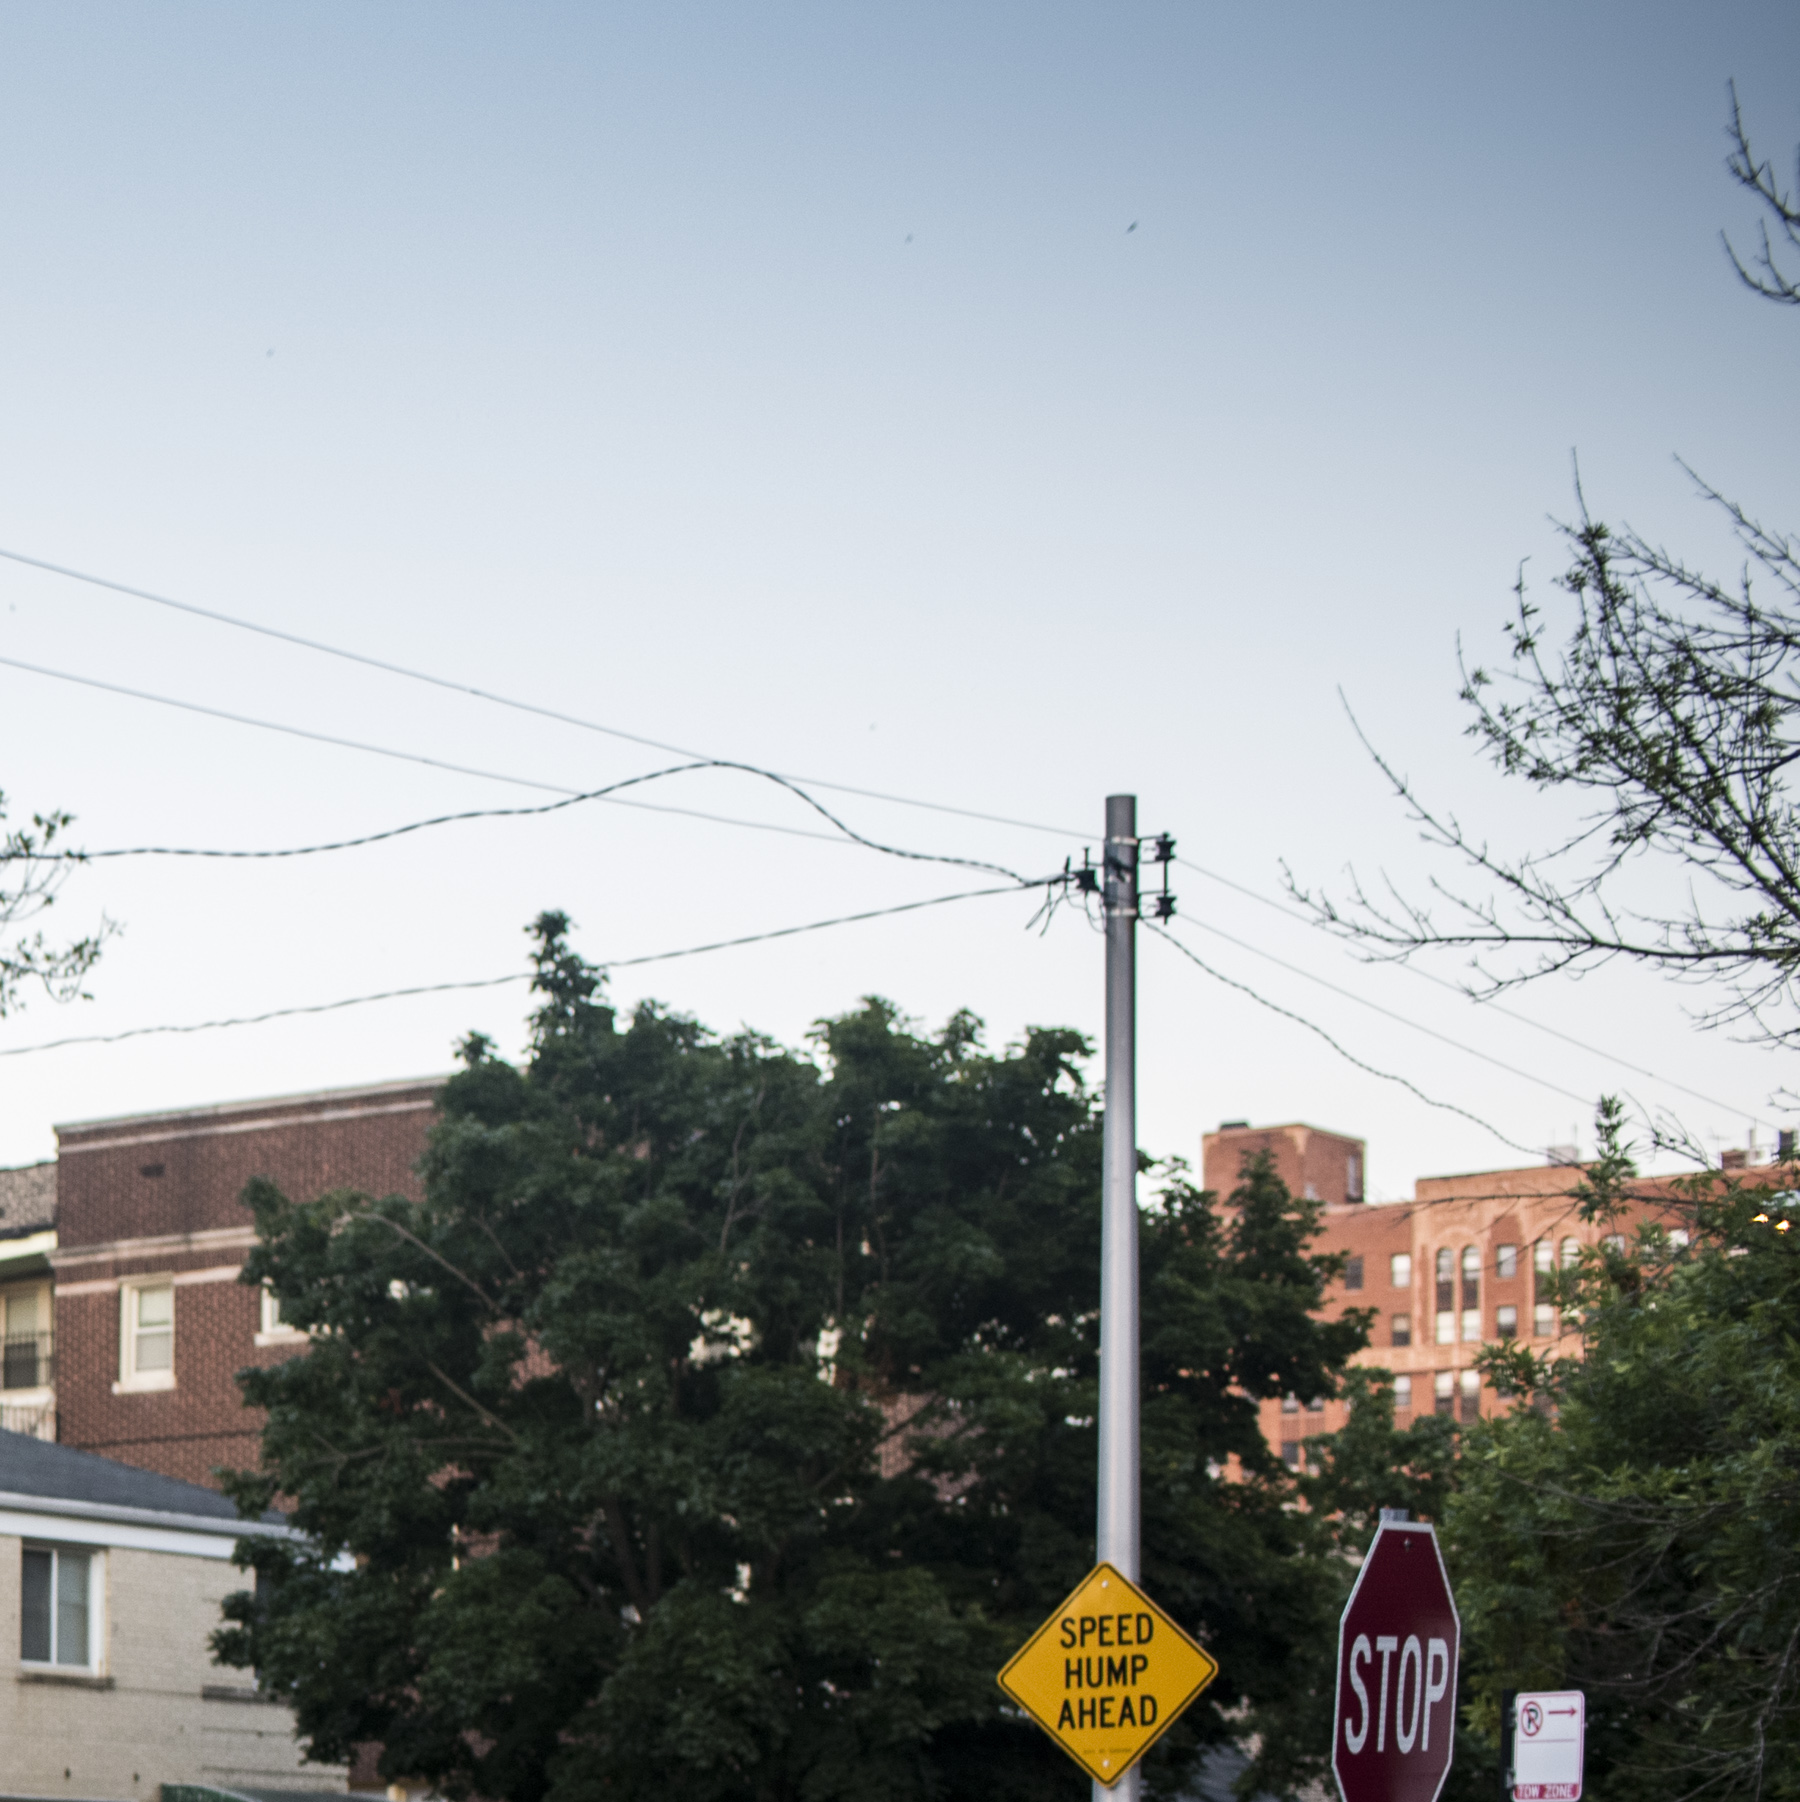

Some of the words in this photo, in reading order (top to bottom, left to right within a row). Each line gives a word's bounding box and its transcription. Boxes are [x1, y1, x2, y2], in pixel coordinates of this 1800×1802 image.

[1060, 1613, 1154, 1648] SPEED
[1065, 1654, 1148, 1689] HUMP
[1345, 1633, 1449, 1755] STOP
[1058, 1694, 1158, 1730] AHEAD
[1518, 1784, 1539, 1799] TOW
[1545, 1784, 1572, 1799] ZONE
